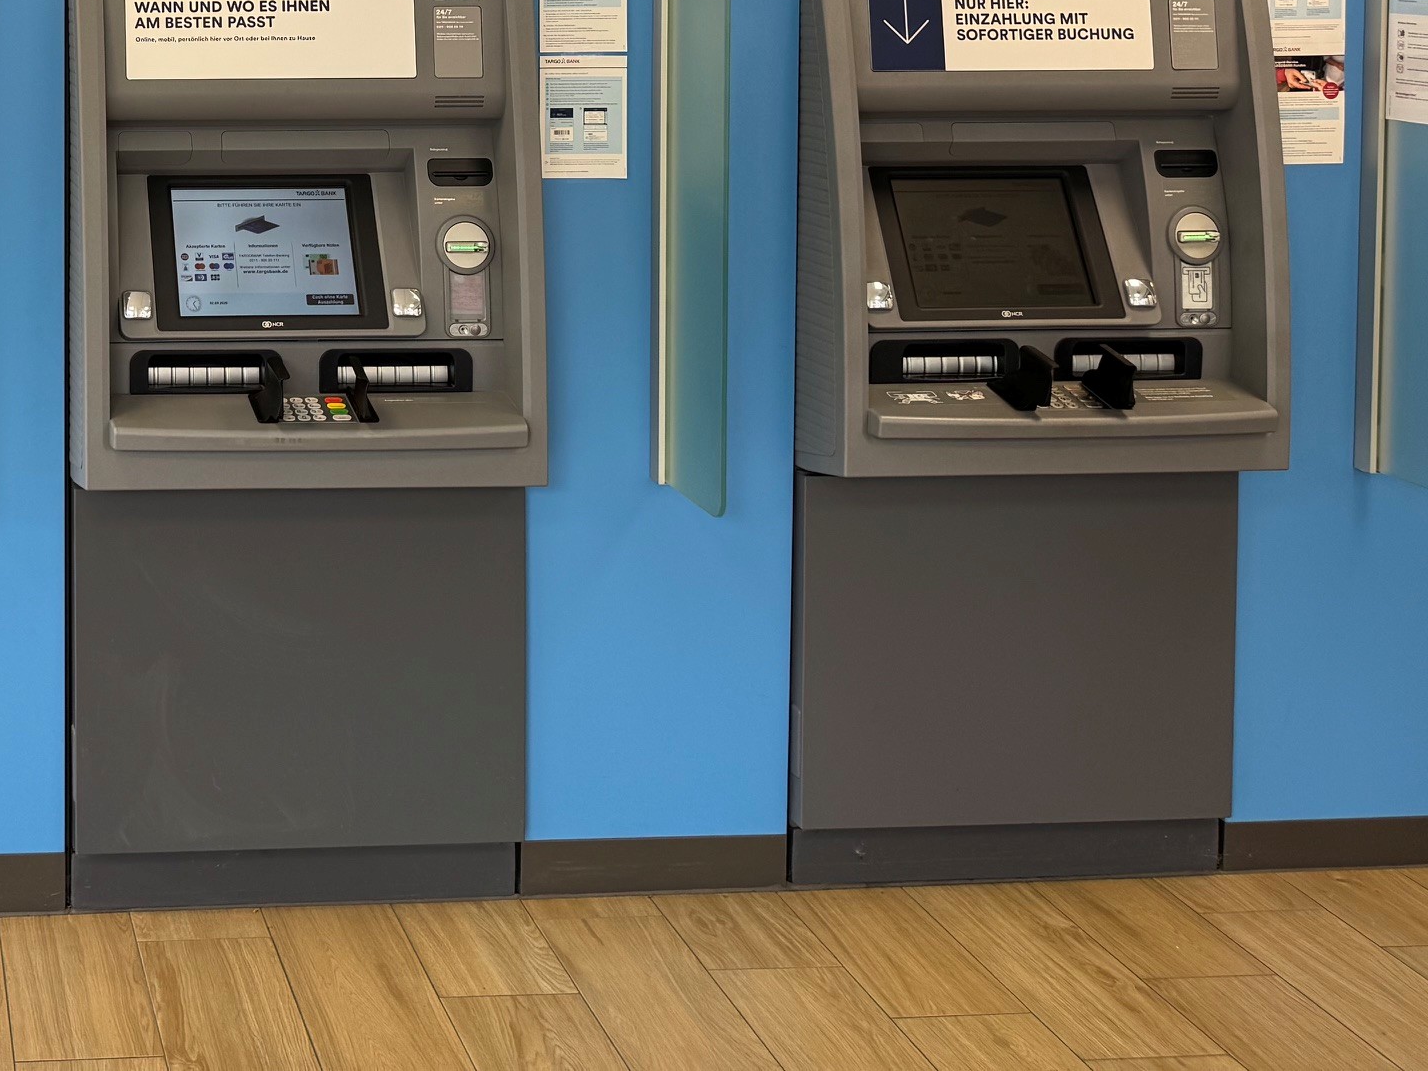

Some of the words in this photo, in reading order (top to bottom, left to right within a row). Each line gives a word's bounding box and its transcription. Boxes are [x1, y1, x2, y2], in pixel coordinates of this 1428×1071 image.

[134, 0, 184, 14] WANN
[189, 0, 223, 13] UND
[226, 0, 255, 13] WO
[259, 0, 278, 13] ES
[281, 0, 330, 13] IHNEN
[134, 16, 160, 29] AM
[165, 16, 223, 29] BESTEN
[227, 15, 276, 29] PASST
[955, 12, 1056, 26] EINZAHLUNG
[1059, 12, 1089, 25] MIT
[178, 35, 209, 43] persönlich
[956, 28, 1054, 41] SOFORTIGER
[1057, 27, 1135, 41] BUCHUNG
